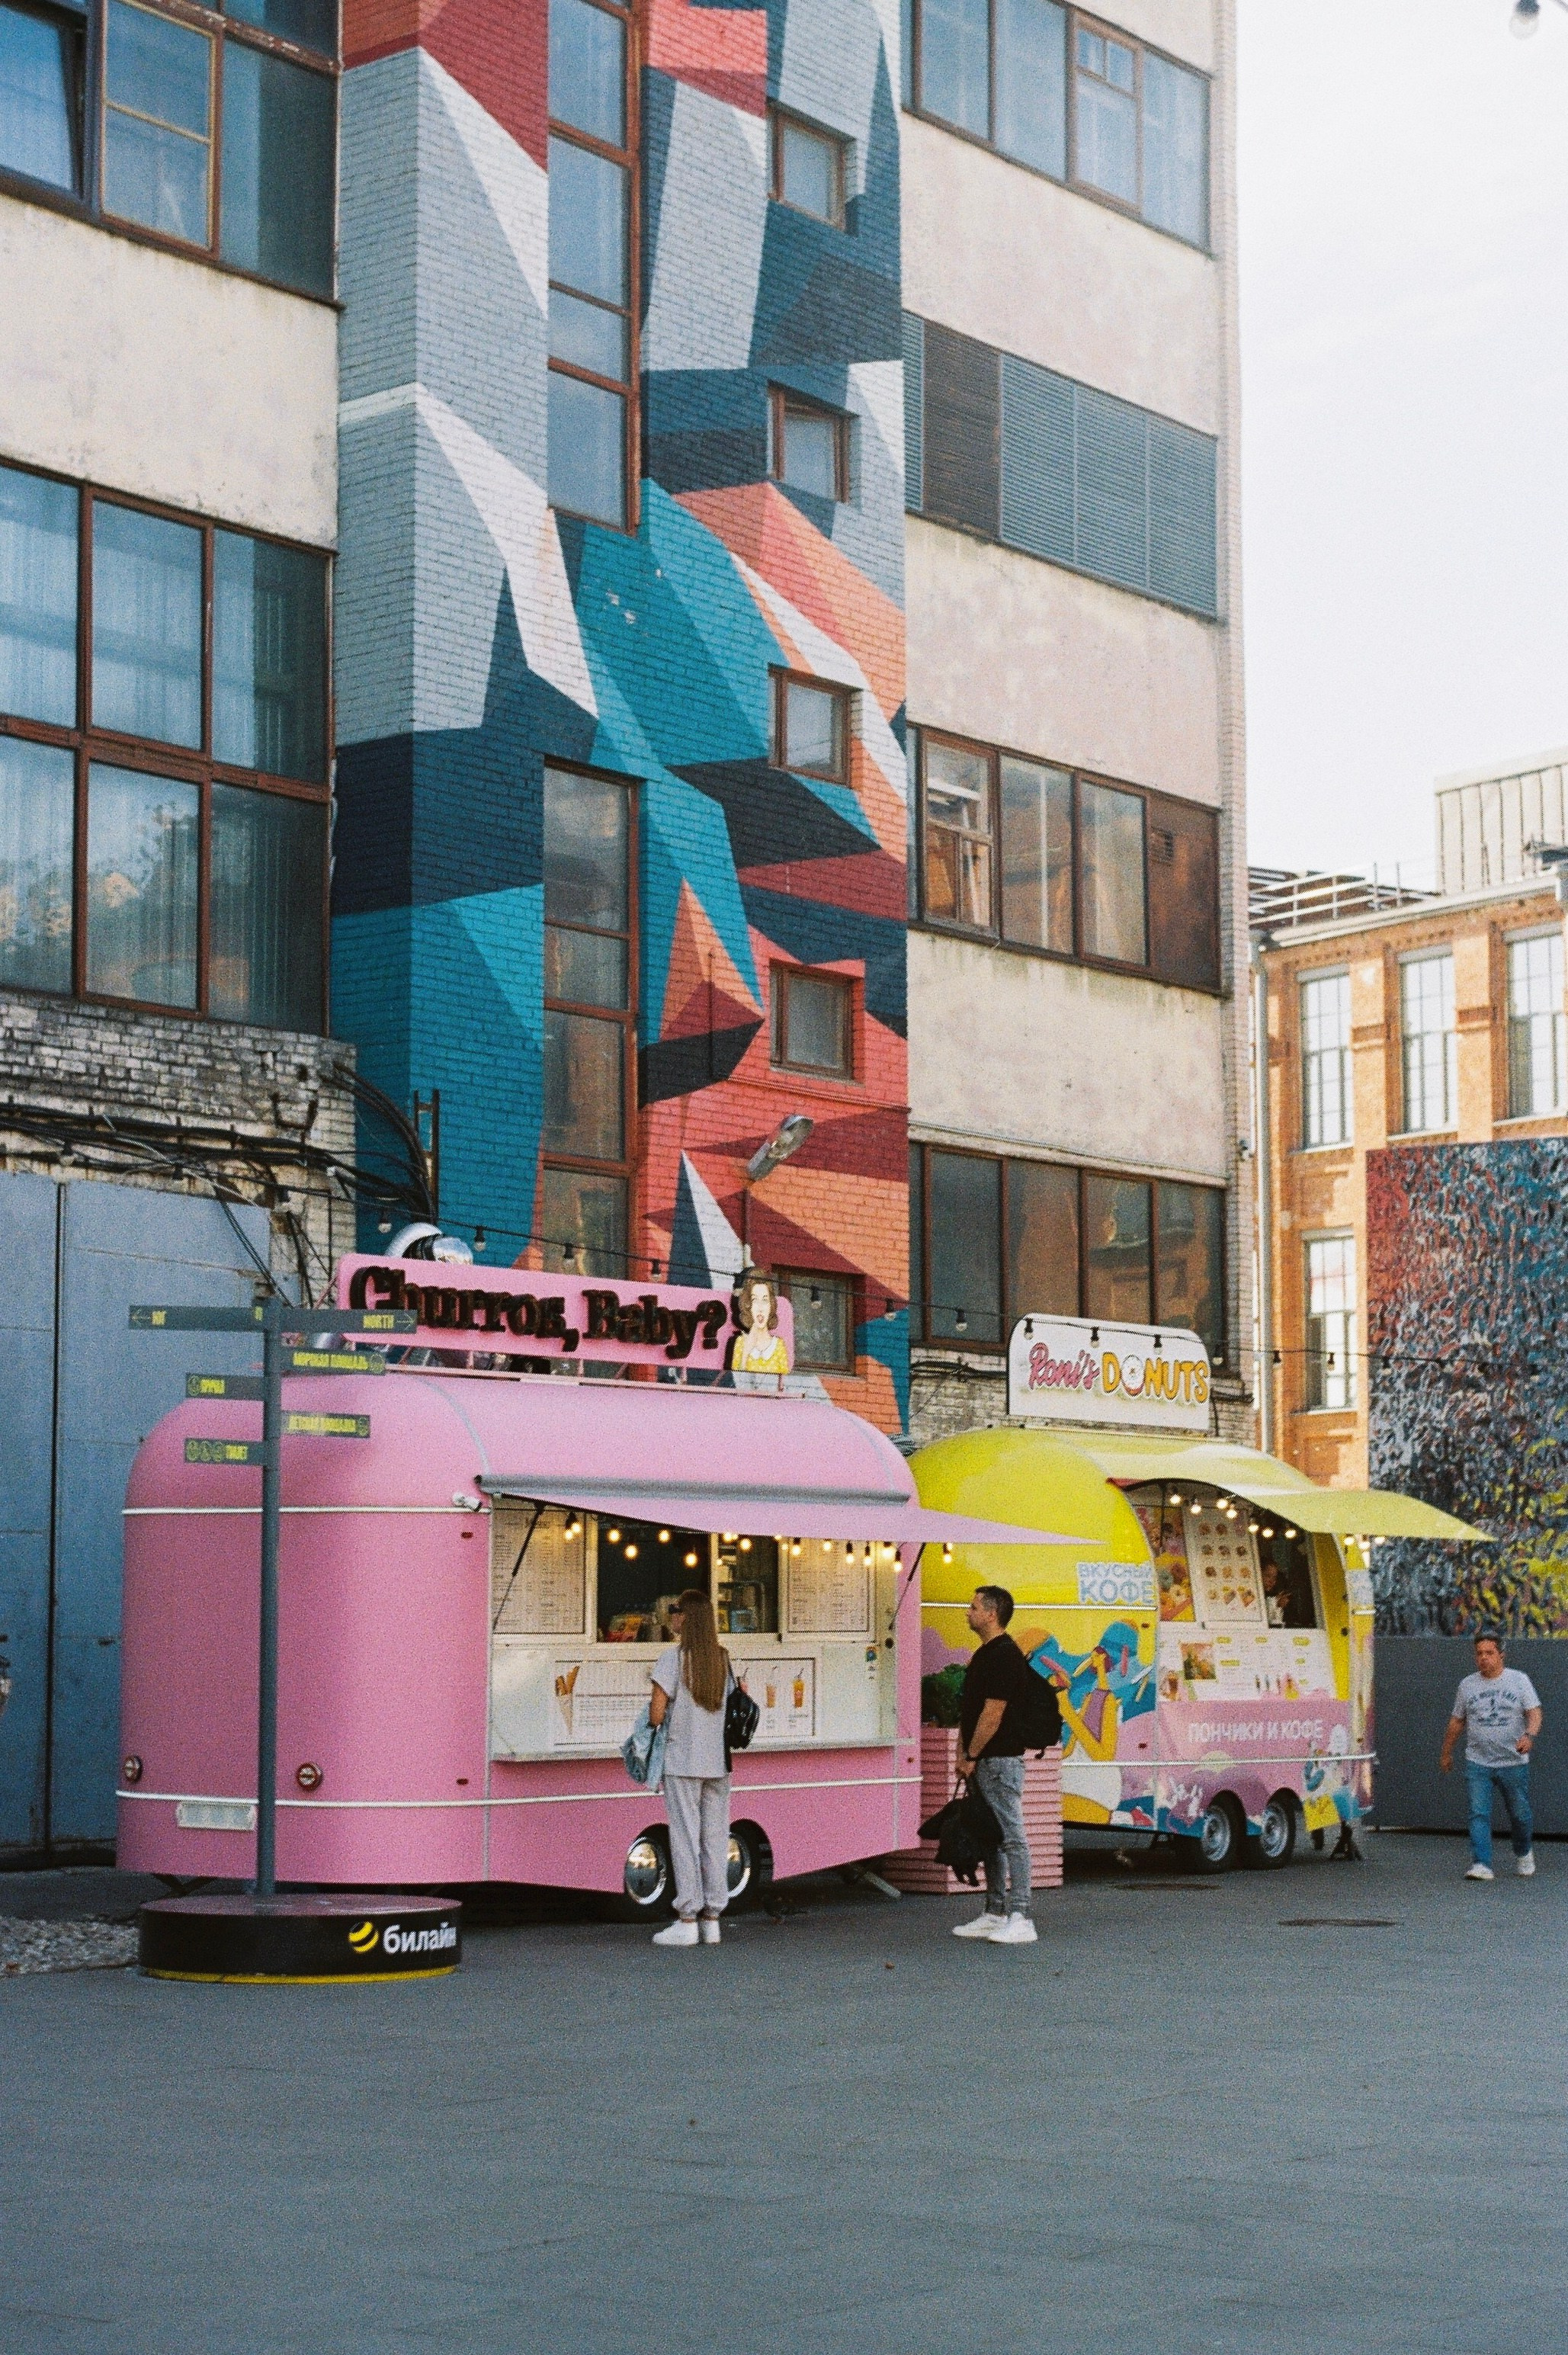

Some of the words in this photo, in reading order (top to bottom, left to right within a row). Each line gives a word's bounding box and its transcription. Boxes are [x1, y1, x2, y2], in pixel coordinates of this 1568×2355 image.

[582, 1288, 728, 1360] Baby?
[1101, 1352, 1209, 1403] DONUTS
[1079, 1578, 1154, 1604] КОФЕ
[1188, 1721, 1262, 1744] ПОНЧИКИ
[1268, 1720, 1280, 1741] И
[1282, 1718, 1324, 1741] КОФЕ
[383, 1921, 457, 1955] билайн
